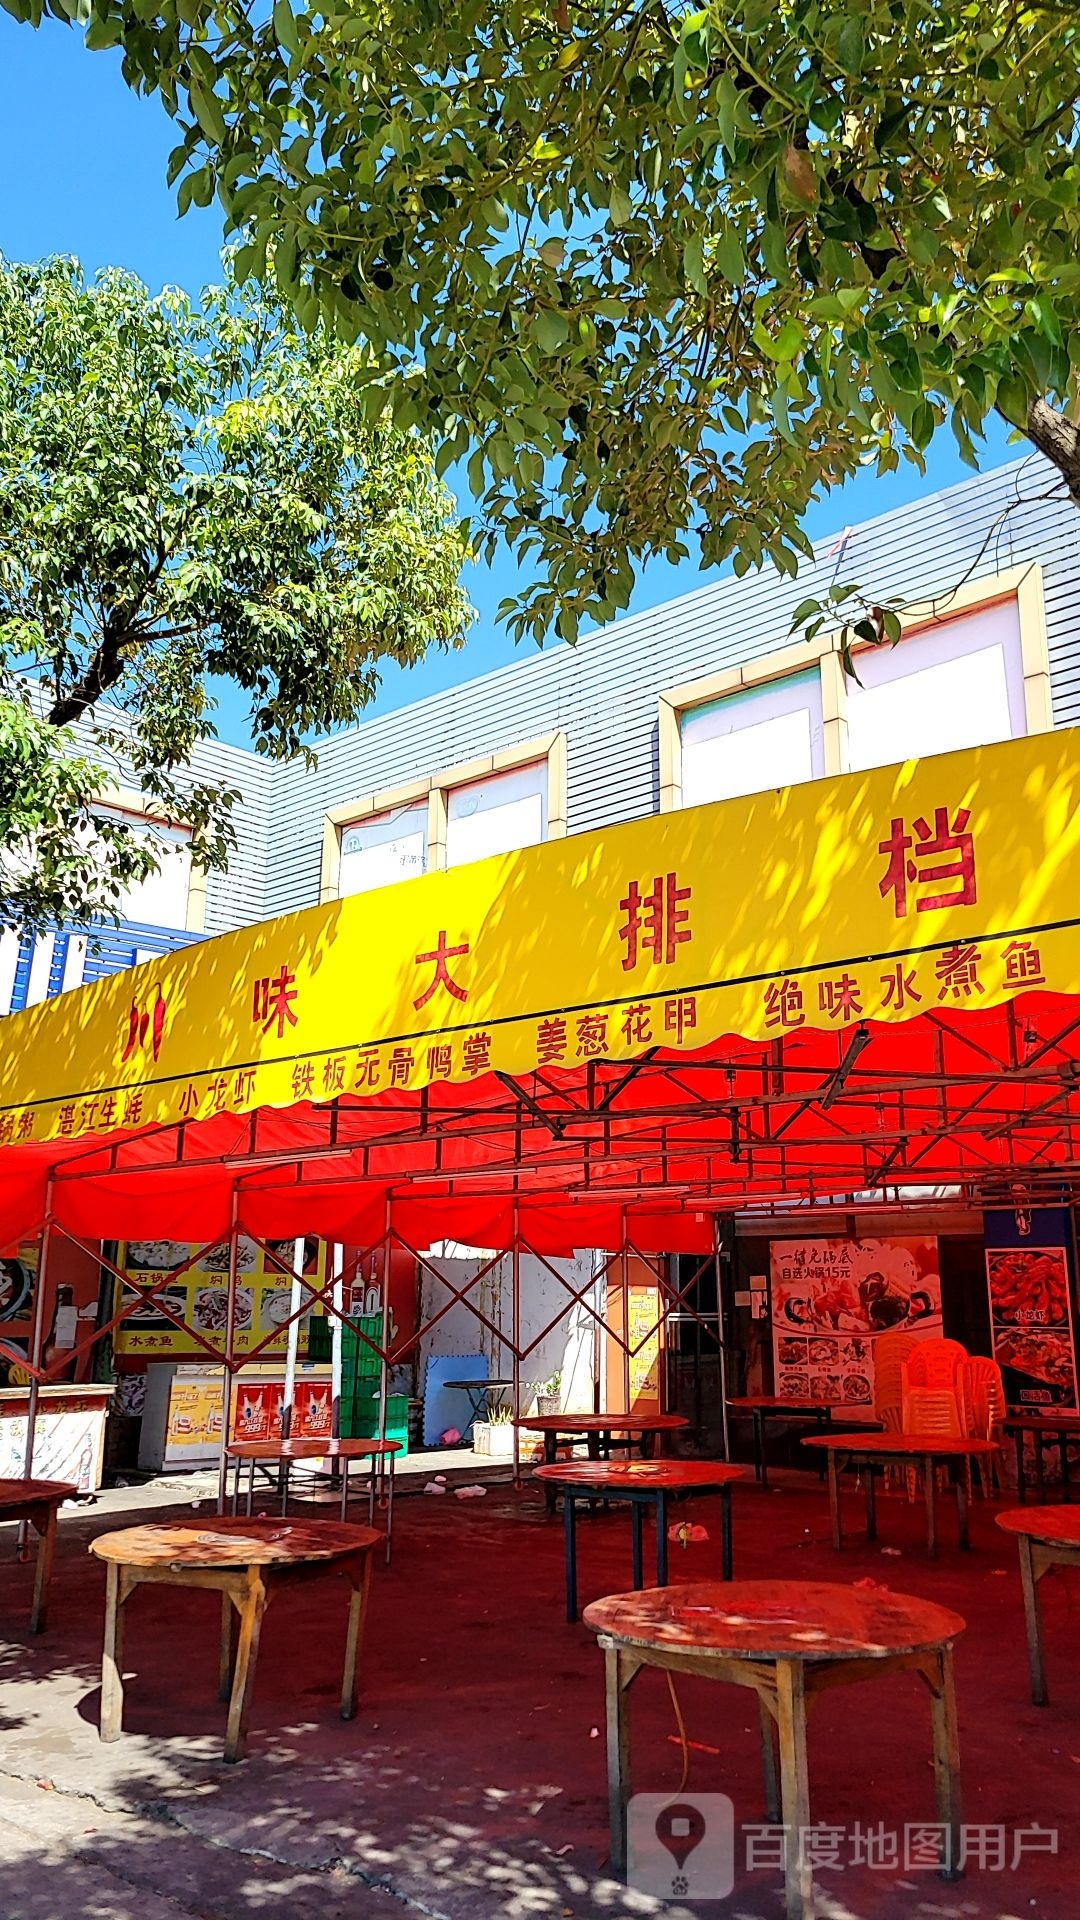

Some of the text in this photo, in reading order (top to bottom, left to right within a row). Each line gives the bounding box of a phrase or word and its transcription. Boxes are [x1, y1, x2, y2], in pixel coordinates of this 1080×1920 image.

[58, 1092, 143, 1135] 湛江生蚝
[178, 1070, 257, 1117] 小龙虾
[290, 1031, 492, 1099] 铁板无骨鸭掌
[536, 996, 697, 1064] 姜葱花甲
[763, 940, 1046, 1028] 绝味水煮鱼
[782, 1266, 851, 1279] 自选火锅15元
[128, 1335, 174, 1347] 水煮鱼
